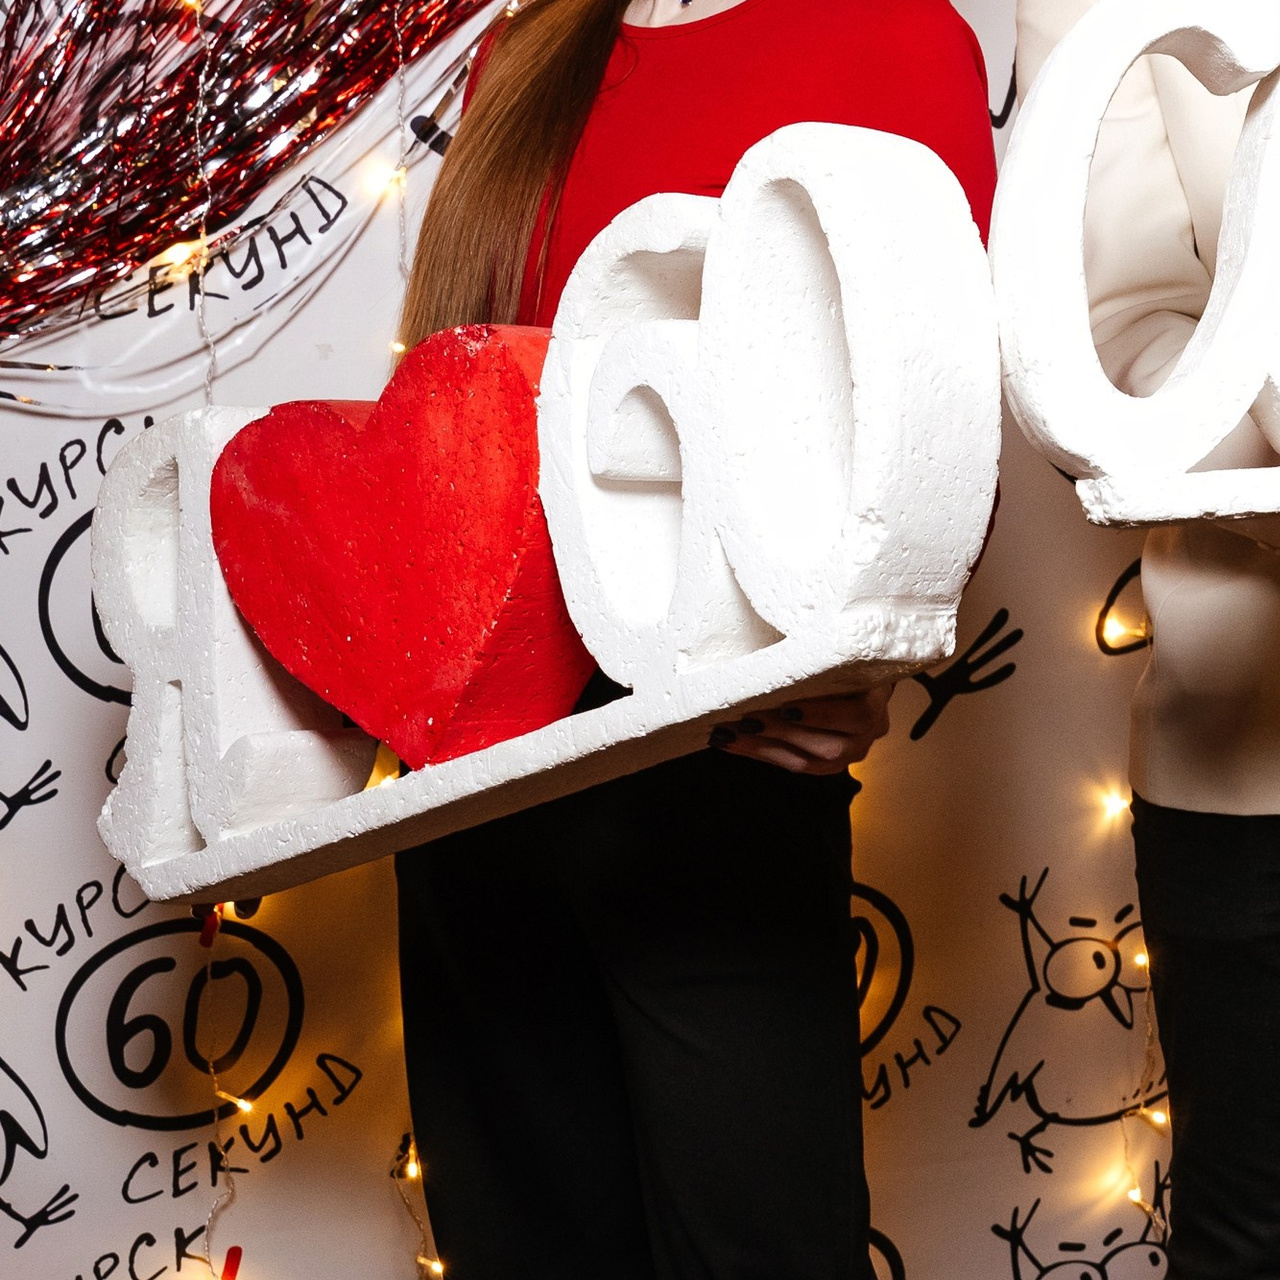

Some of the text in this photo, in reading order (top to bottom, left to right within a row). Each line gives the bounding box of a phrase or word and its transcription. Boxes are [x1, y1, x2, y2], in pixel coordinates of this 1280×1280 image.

[536, 121, 1000, 680] 60
[0, 862, 150, 991] КУРС
[106, 956, 262, 1089] 60
[122, 1053, 363, 1204] СЕКУНД
